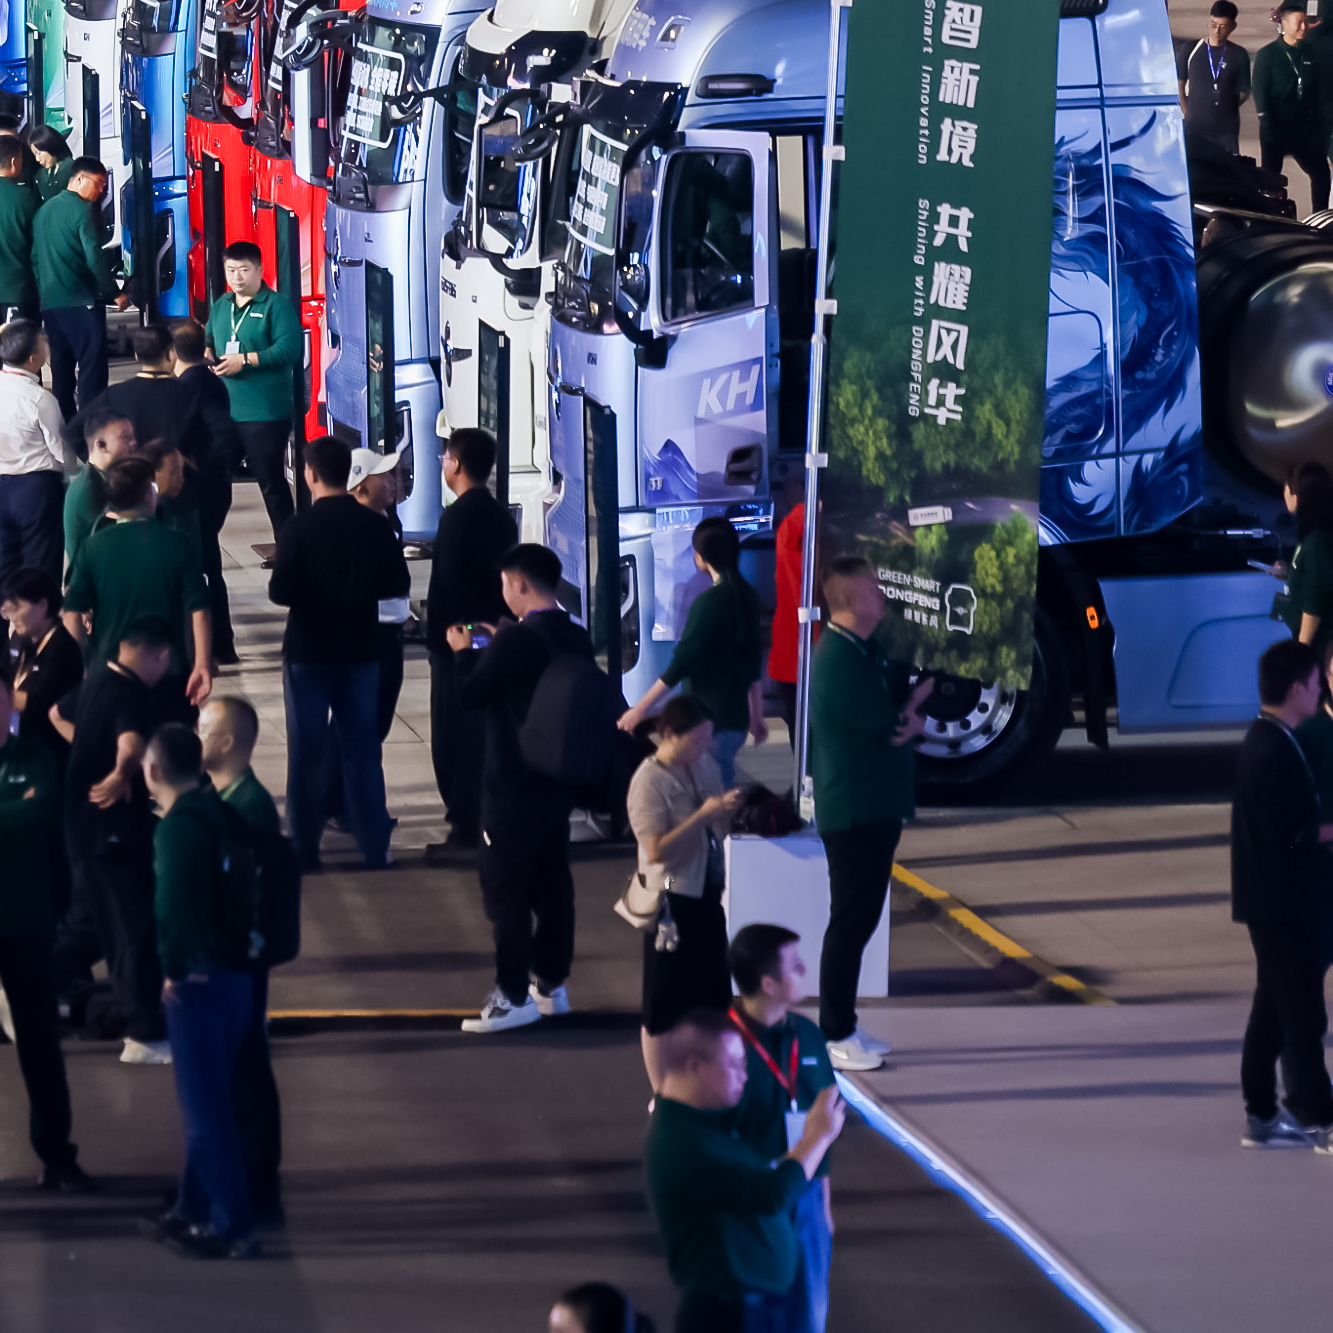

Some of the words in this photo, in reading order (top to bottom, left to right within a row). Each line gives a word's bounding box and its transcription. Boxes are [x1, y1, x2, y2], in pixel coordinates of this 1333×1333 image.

[918, 65, 933, 165] Innovation
[913, 198, 930, 266] Shining
[912, 276, 925, 317] with
[924, 202, 974, 425] 共耀风华
[697, 364, 760, 417] KH
[908, 326, 924, 418] DONGFENG
